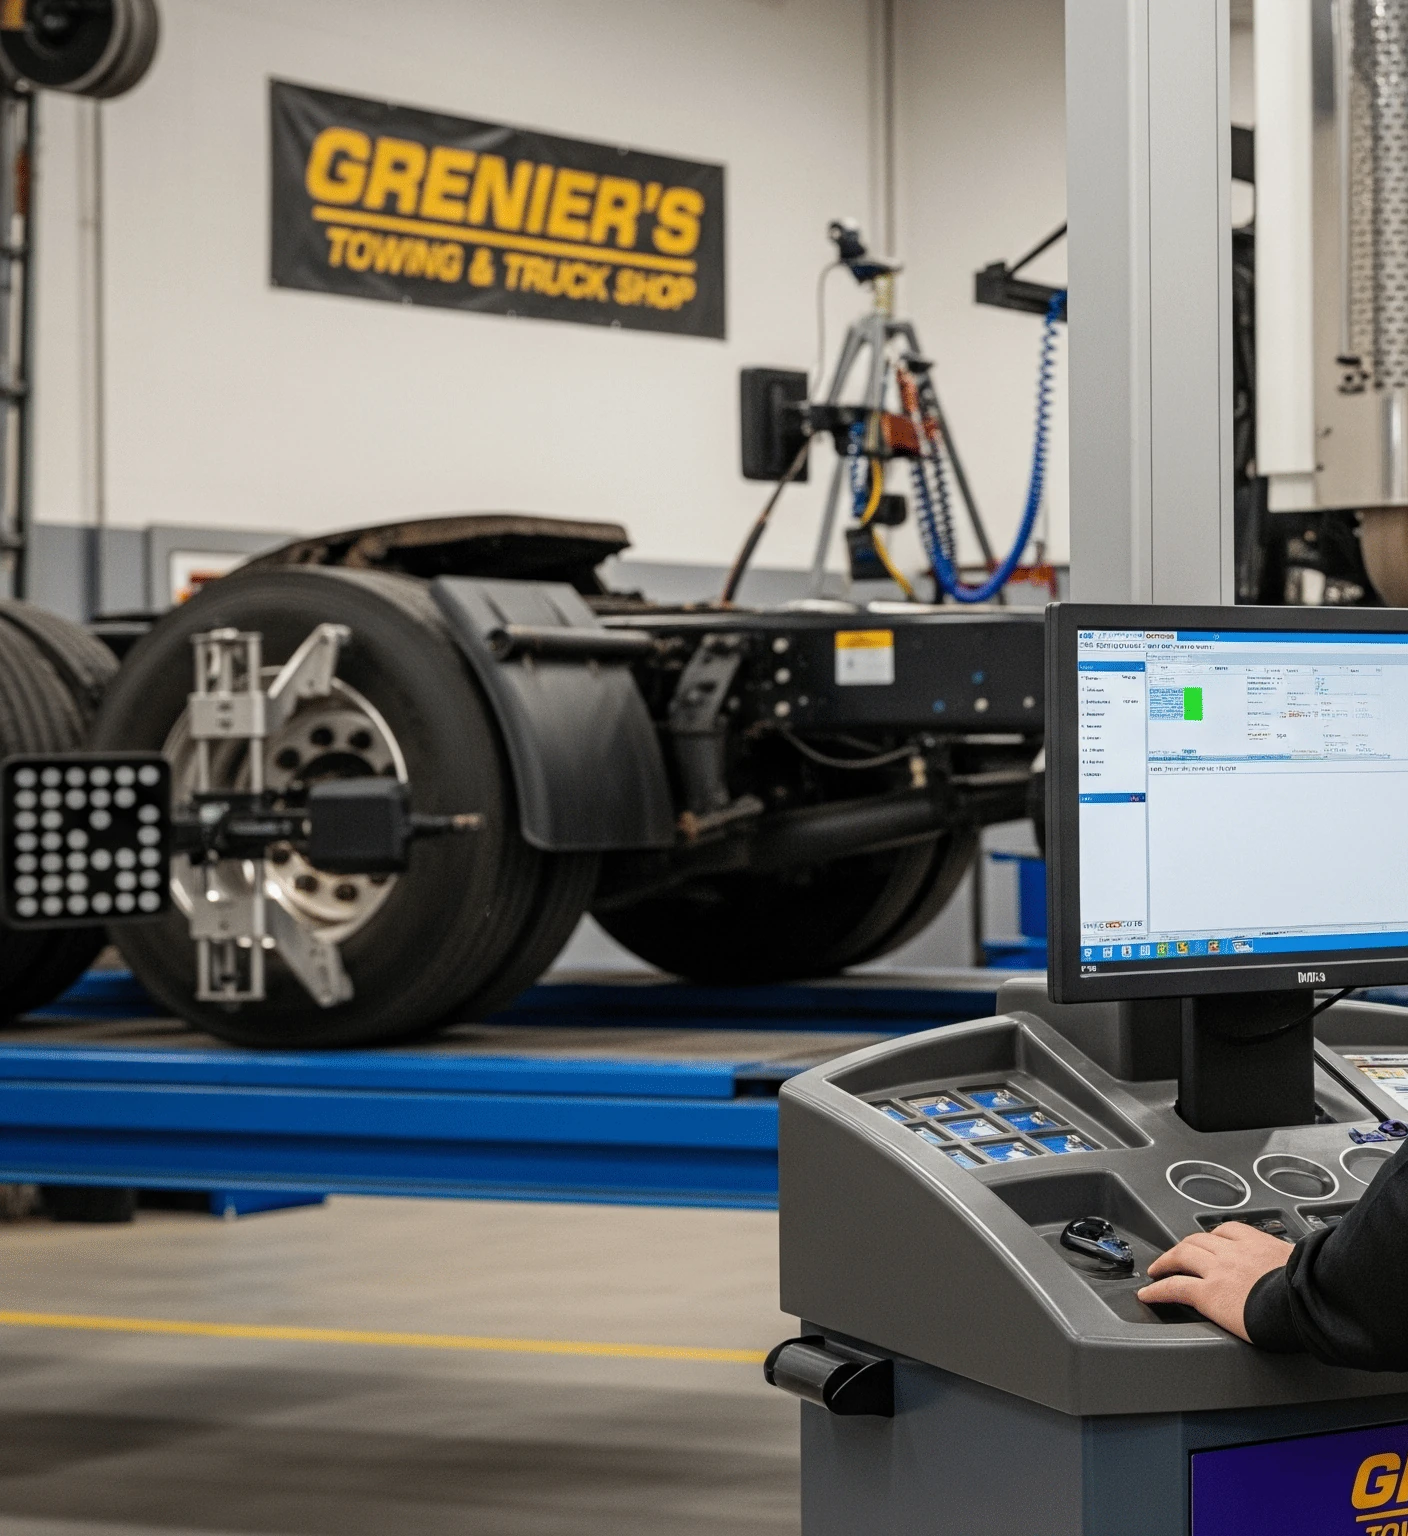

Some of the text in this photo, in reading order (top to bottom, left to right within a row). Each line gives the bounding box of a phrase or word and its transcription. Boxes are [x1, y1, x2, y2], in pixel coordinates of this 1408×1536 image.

[305, 127, 705, 256] GRENIER'S
[325, 226, 697, 311] TOWING & TRUCK SHOP
